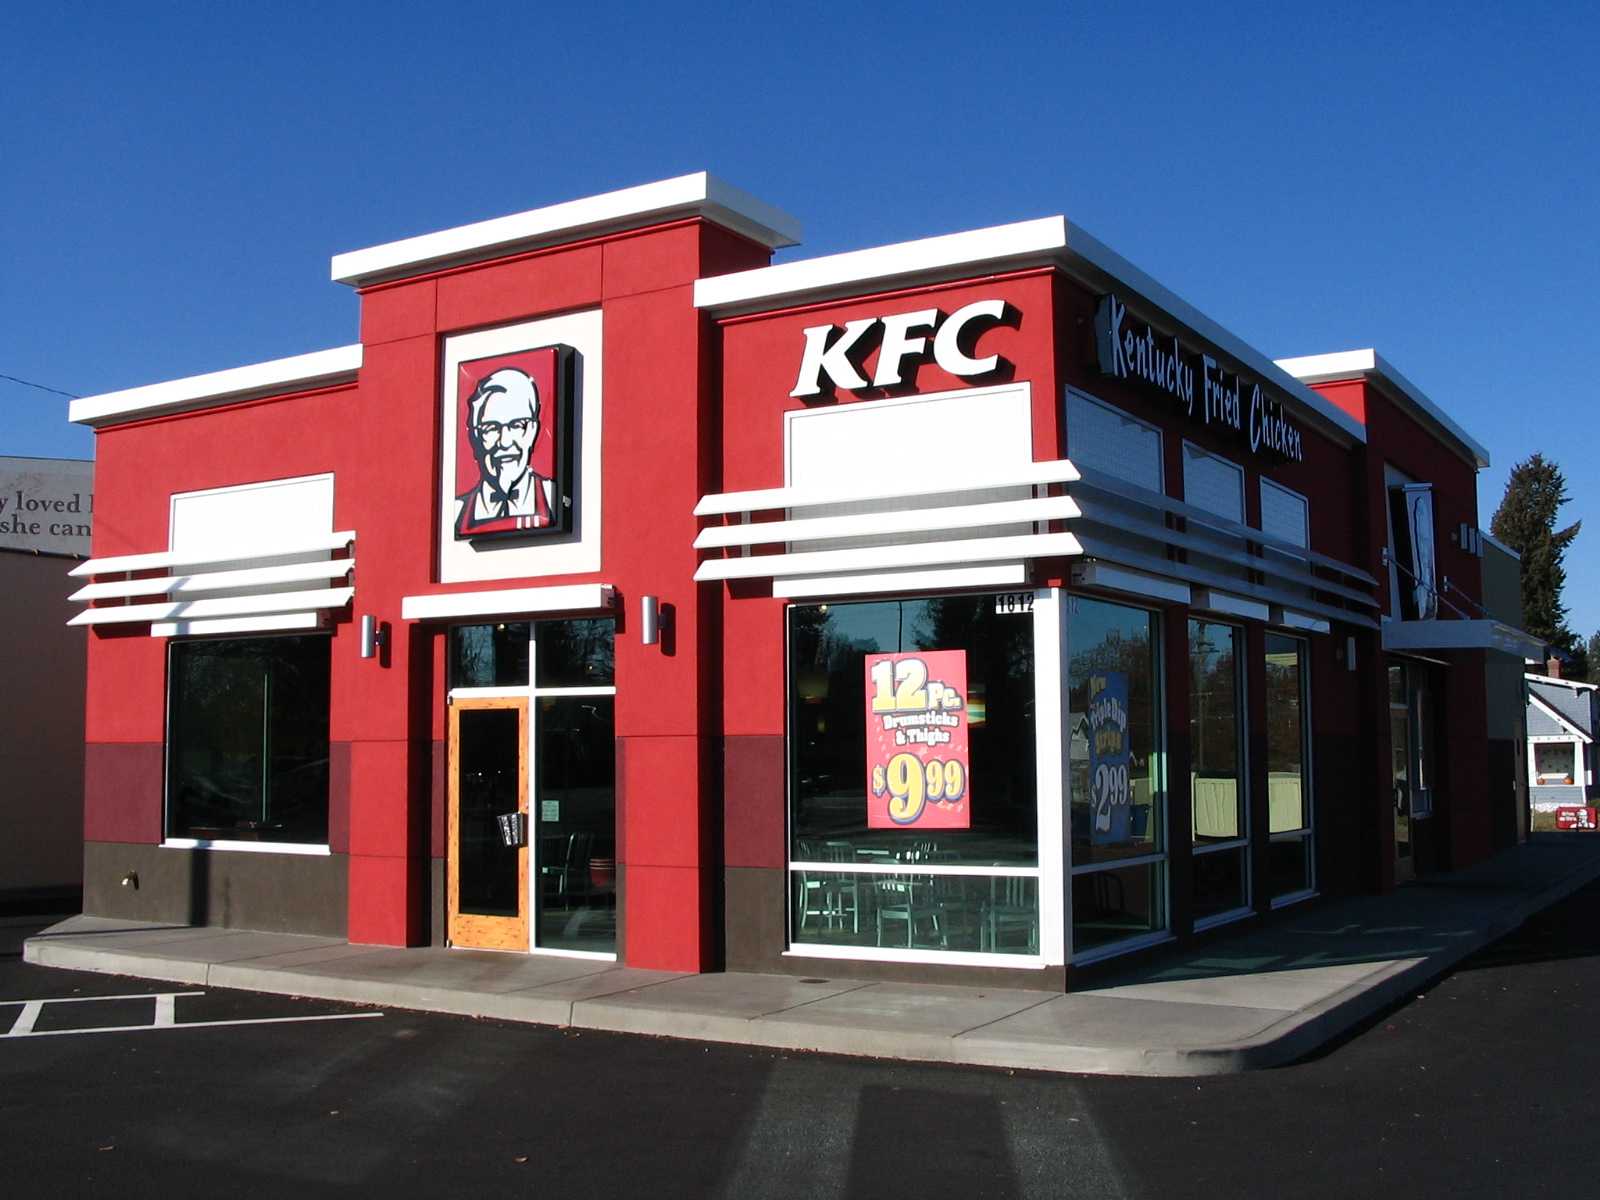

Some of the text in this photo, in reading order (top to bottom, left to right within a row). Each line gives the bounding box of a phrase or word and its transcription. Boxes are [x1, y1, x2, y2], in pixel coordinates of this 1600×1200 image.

[788, 299, 1006, 397] KFC
[1110, 294, 1303, 462] Kentucky Fried Chicken
[14, 490, 82, 513] loved
[0, 513, 92, 537] she can
[998, 592, 1034, 613] 1812
[871, 658, 928, 713] 12
[882, 711, 960, 730] Drumsticks
[1111, 697, 1127, 732] Dip
[895, 728, 951, 746] & Thighs
